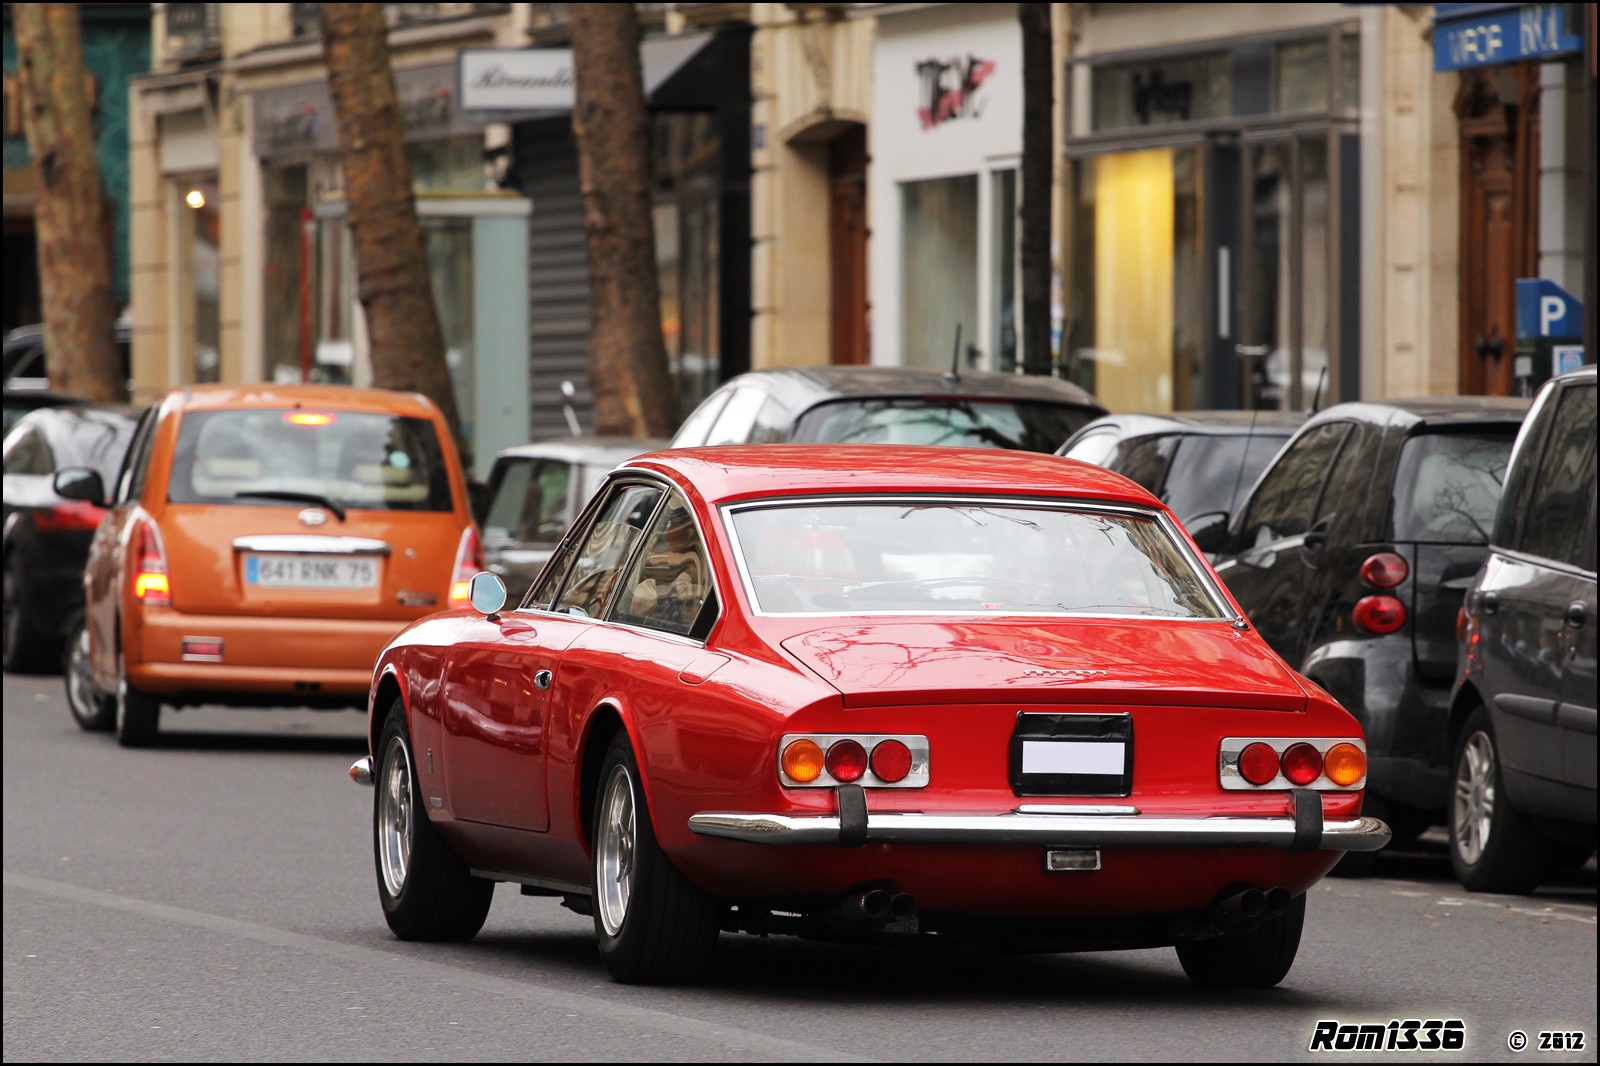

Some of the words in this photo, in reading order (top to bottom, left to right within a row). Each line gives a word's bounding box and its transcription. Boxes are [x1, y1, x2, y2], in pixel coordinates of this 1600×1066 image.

[1541, 295, 1566, 336] P
[260, 561, 294, 580] 641
[346, 561, 372, 583] 75
